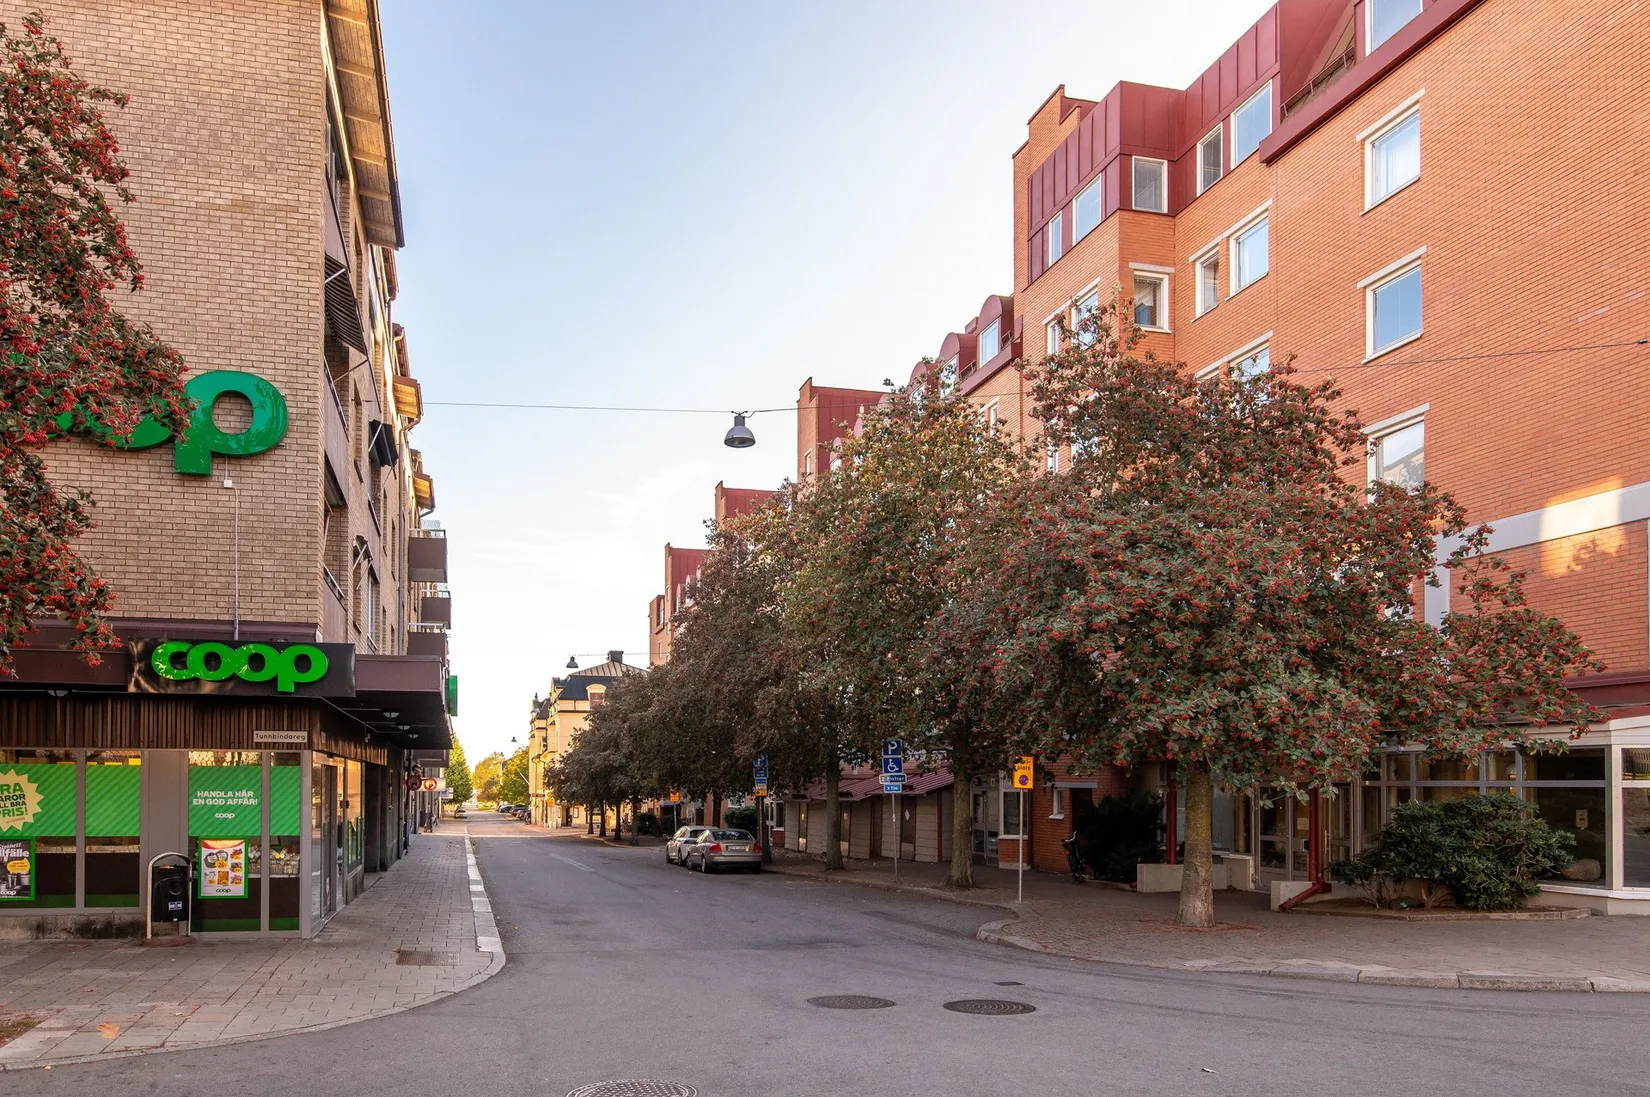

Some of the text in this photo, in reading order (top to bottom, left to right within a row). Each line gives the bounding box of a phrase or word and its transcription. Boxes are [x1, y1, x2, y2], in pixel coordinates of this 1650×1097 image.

[152, 641, 329, 692] coop
[888, 741, 898, 754] P
[197, 789, 254, 798] HANDLA HÄR
[226, 797, 258, 805] AFFÄR!
[0, 807, 28, 818] RIS!
